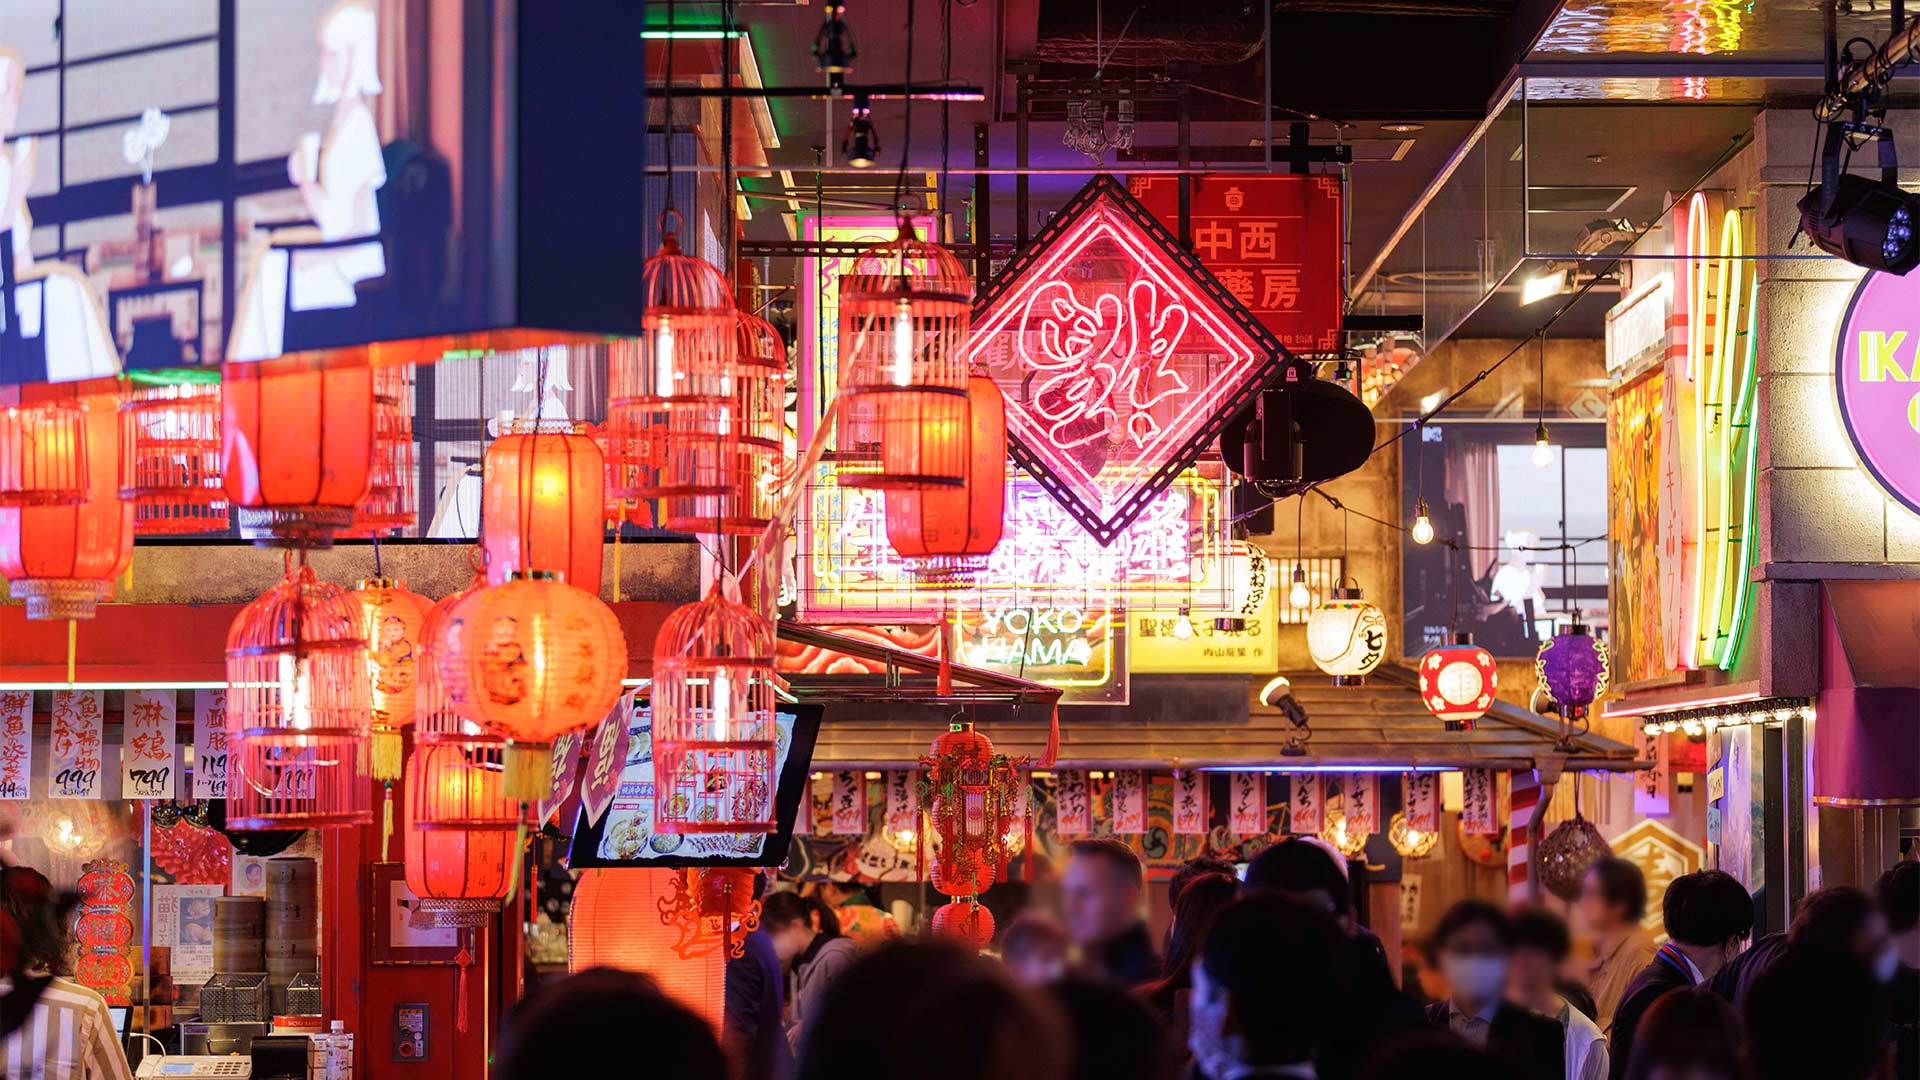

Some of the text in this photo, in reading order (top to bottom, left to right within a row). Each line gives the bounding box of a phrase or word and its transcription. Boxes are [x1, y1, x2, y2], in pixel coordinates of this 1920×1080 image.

[1194, 220, 1278, 260] 中西
[984, 609, 1083, 635] YOKO
[56, 768, 97, 789] 999
[129, 767, 170, 790] 799
